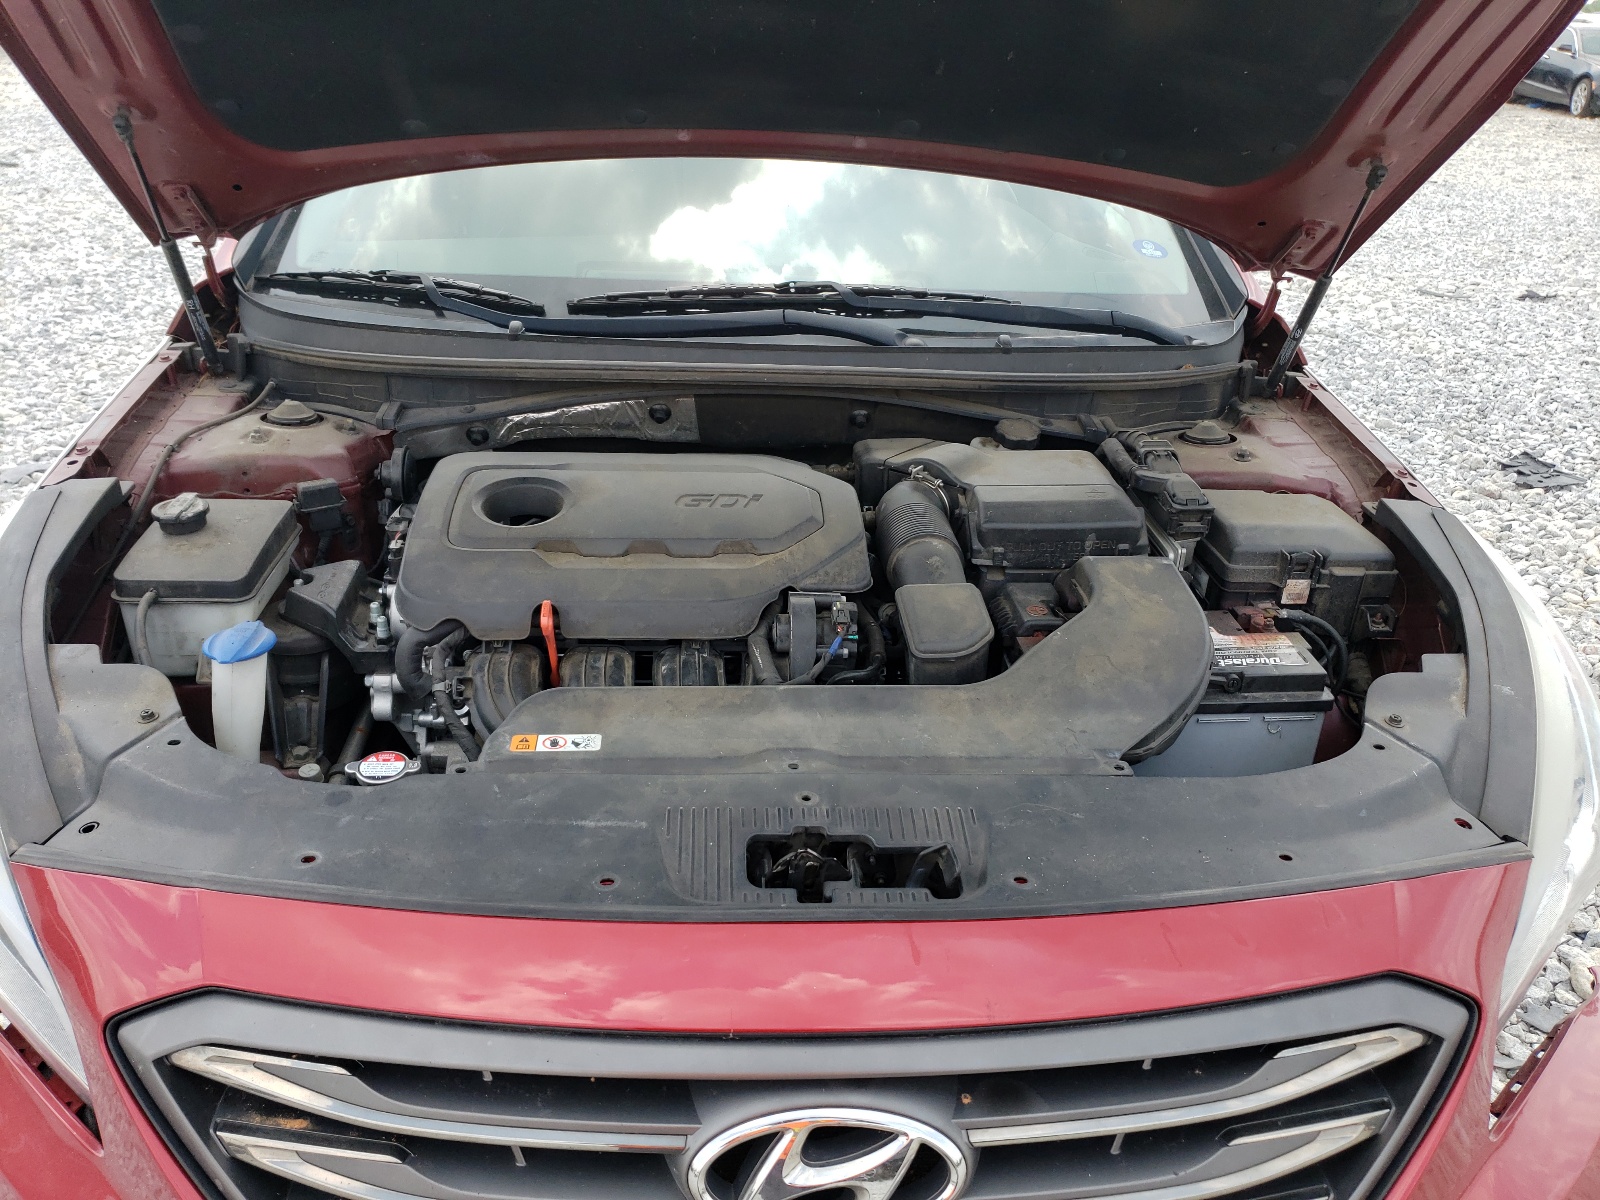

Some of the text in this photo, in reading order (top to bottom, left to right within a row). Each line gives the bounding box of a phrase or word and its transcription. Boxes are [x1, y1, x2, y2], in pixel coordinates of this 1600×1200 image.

[1005, 539, 1116, 552] PULL OUT TO OPEN
[1217, 657, 1281, 666] Duralast
